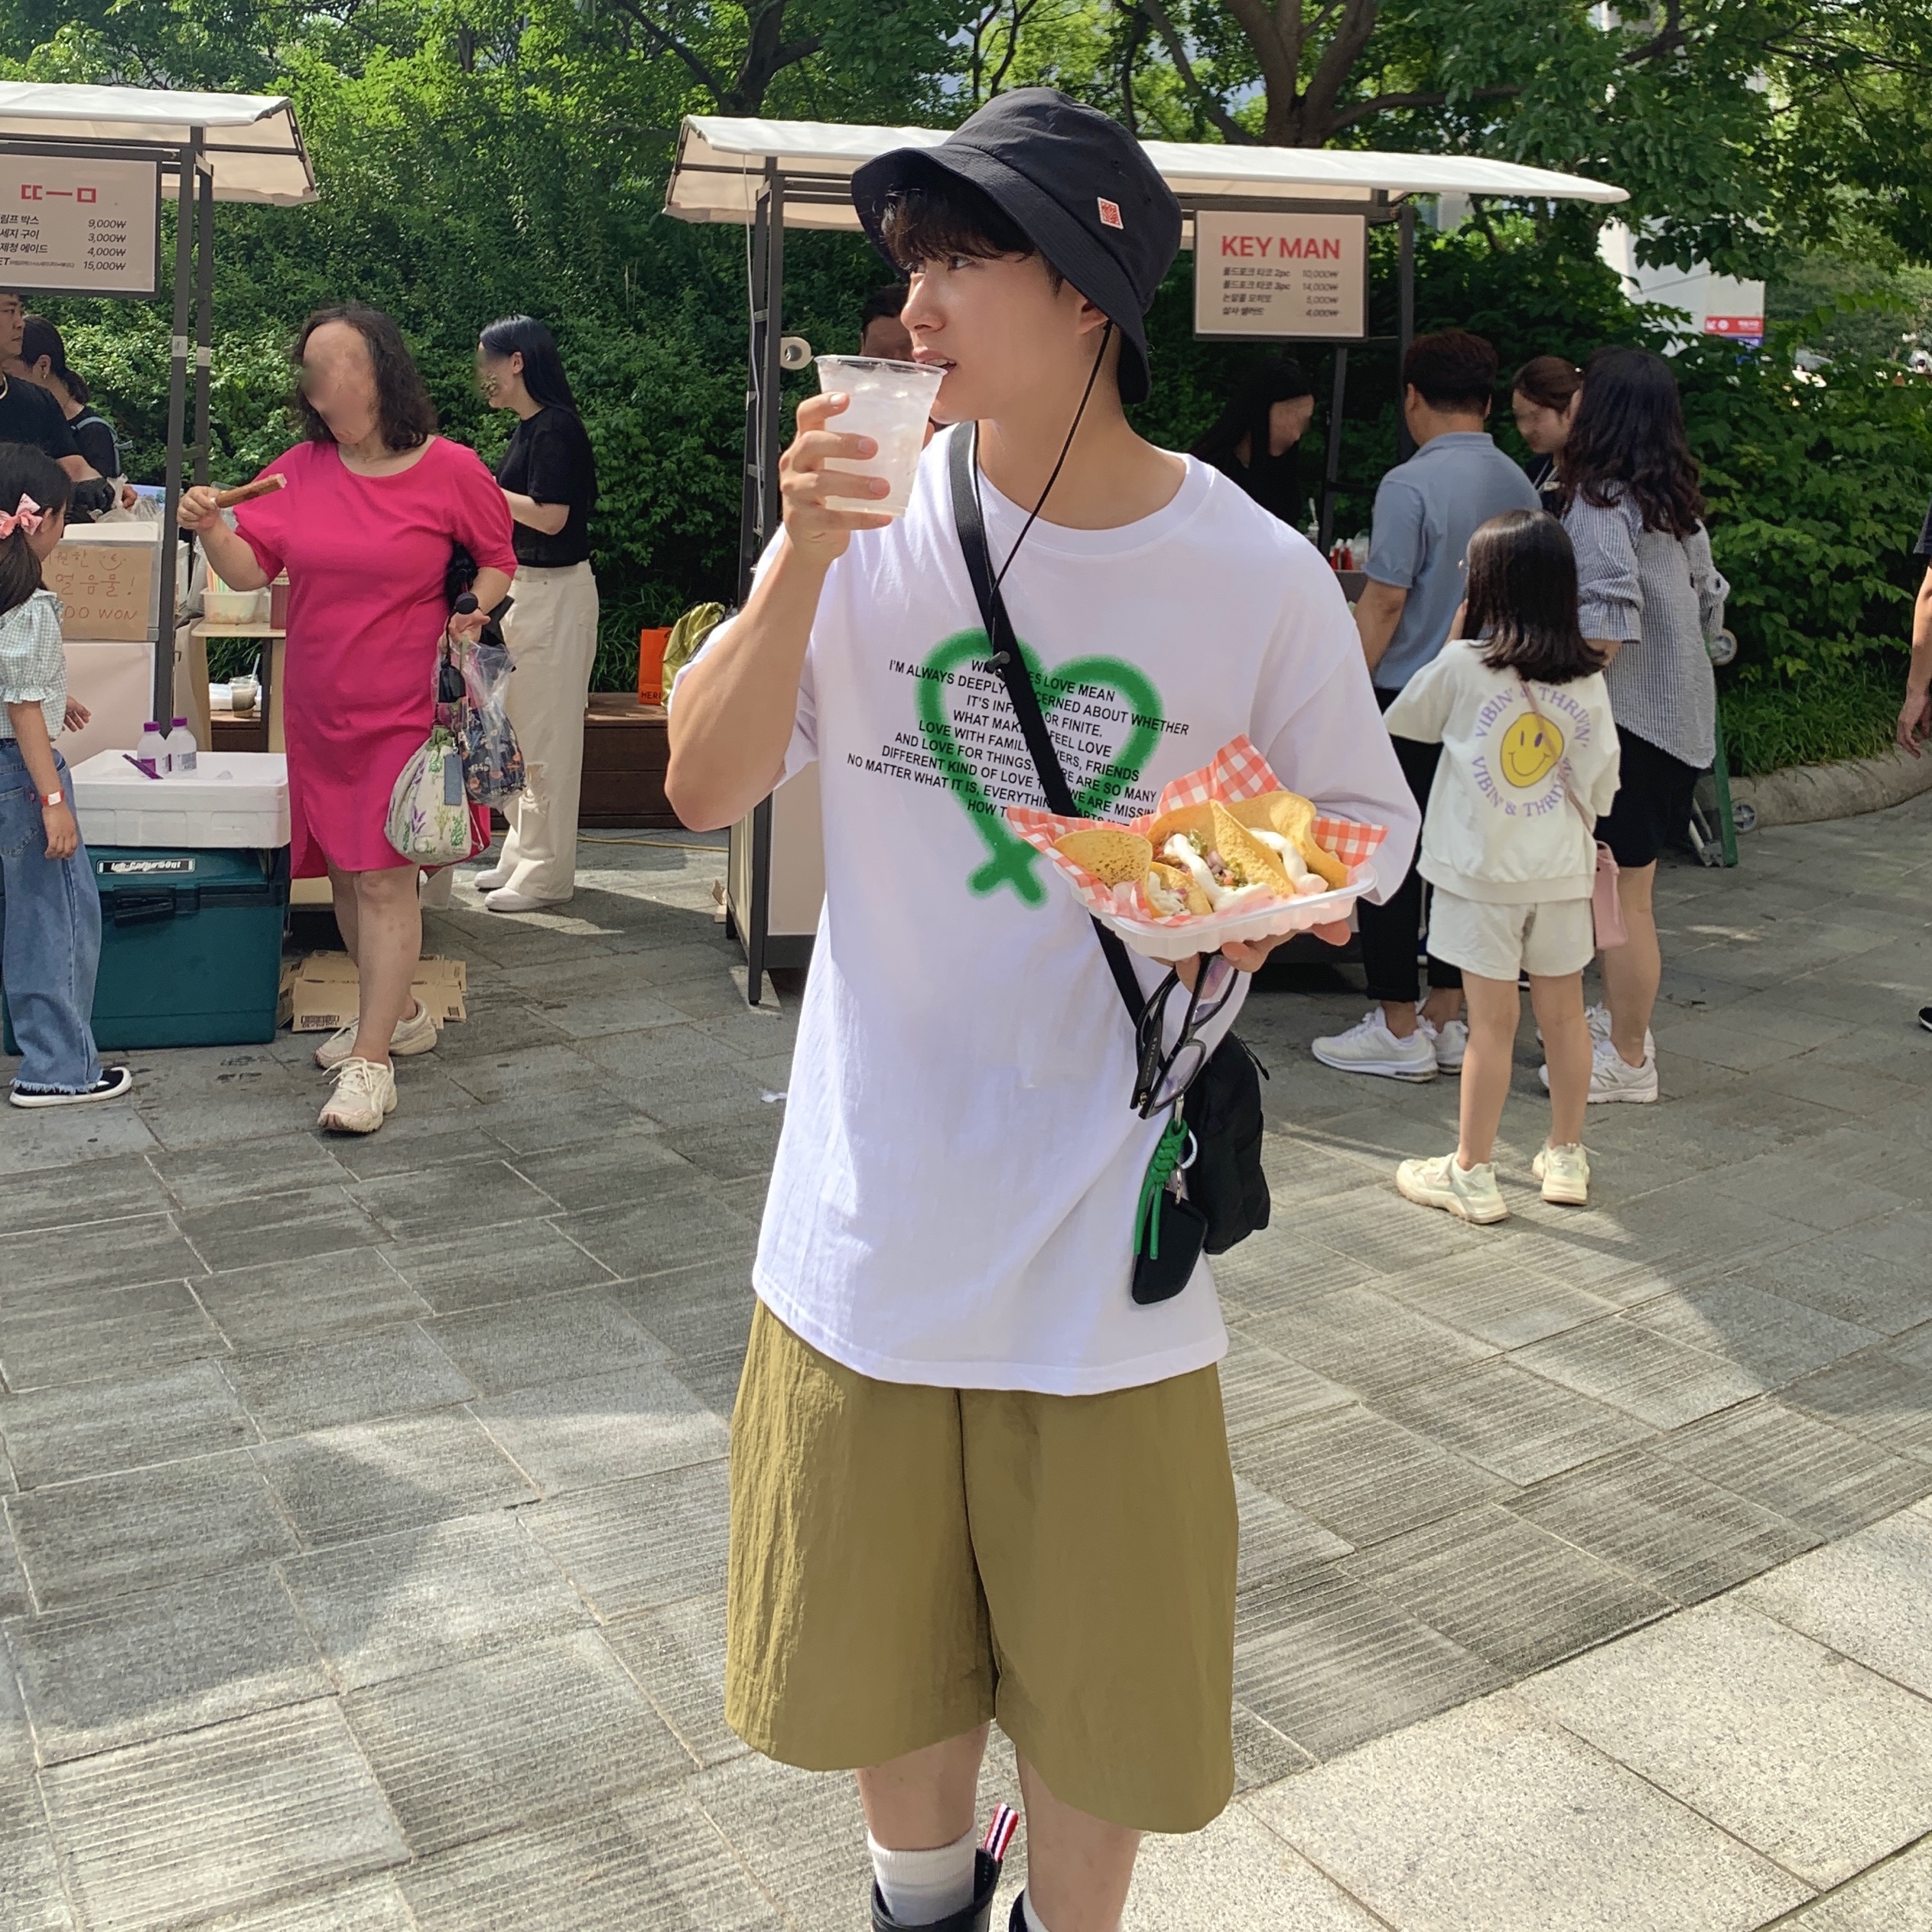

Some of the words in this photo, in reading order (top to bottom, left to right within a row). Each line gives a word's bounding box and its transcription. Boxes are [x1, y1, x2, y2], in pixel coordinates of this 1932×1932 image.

[0, 214, 18, 224] 림프
[21, 215, 40, 225] 박스
[0, 229, 18, 239] 세지
[21, 229, 40, 239] 구이
[0, 242, 18, 252] 제청
[20, 243, 48, 253] 에이드
[1221, 236, 1273, 257] KEY
[1280, 237, 1341, 259] MAN
[49, 550, 89, 568] 원한
[99, 609, 138, 620] WON
[890, 660, 905, 673] I'M
[906, 664, 955, 684] ALWAYS
[958, 675, 1006, 694] DEEPLY
[1035, 691, 1081, 713] CERNED
[1083, 704, 1128, 723] ABOUT
[1131, 713, 1189, 735] WHETHER
[1044, 676, 1075, 693] LOVE
[1078, 684, 1115, 702] MEAN
[967, 694, 990, 709] IT'S
[1045, 711, 1059, 726] OR
[1062, 717, 1102, 737] FINITE.
[954, 710, 989, 726] WHAT
[1049, 730, 1076, 749] FEEL
[1078, 740, 1112, 757] LOVE
[919, 720, 951, 737] LOVE
[955, 727, 985, 743] WITH
[1085, 759, 1140, 782] FRIENDS
[882, 745, 945, 770] DIFFERENT
[948, 760, 977, 775] KIND
[981, 767, 998, 779] OF
[1000, 771, 1033, 788] LOVE
[1088, 796, 1111, 812] ARE
[895, 732, 918, 746] AND
[922, 739, 954, 754] LOVE
[958, 745, 983, 759] FOR
[987, 750, 1034, 771] THINGS.
[1076, 776, 1100, 791] ARE
[1104, 783, 1120, 796] SO
[1124, 787, 1156, 802] MANY
[847, 753, 863, 767] NO
[865, 759, 911, 780] MATTER
[914, 771, 948, 788] WHAT
[951, 779, 961, 790] IT
[965, 781, 980, 795] IS,
[984, 785, 1050, 808] EVERYTHIN
[968, 799, 997, 815] HOW
